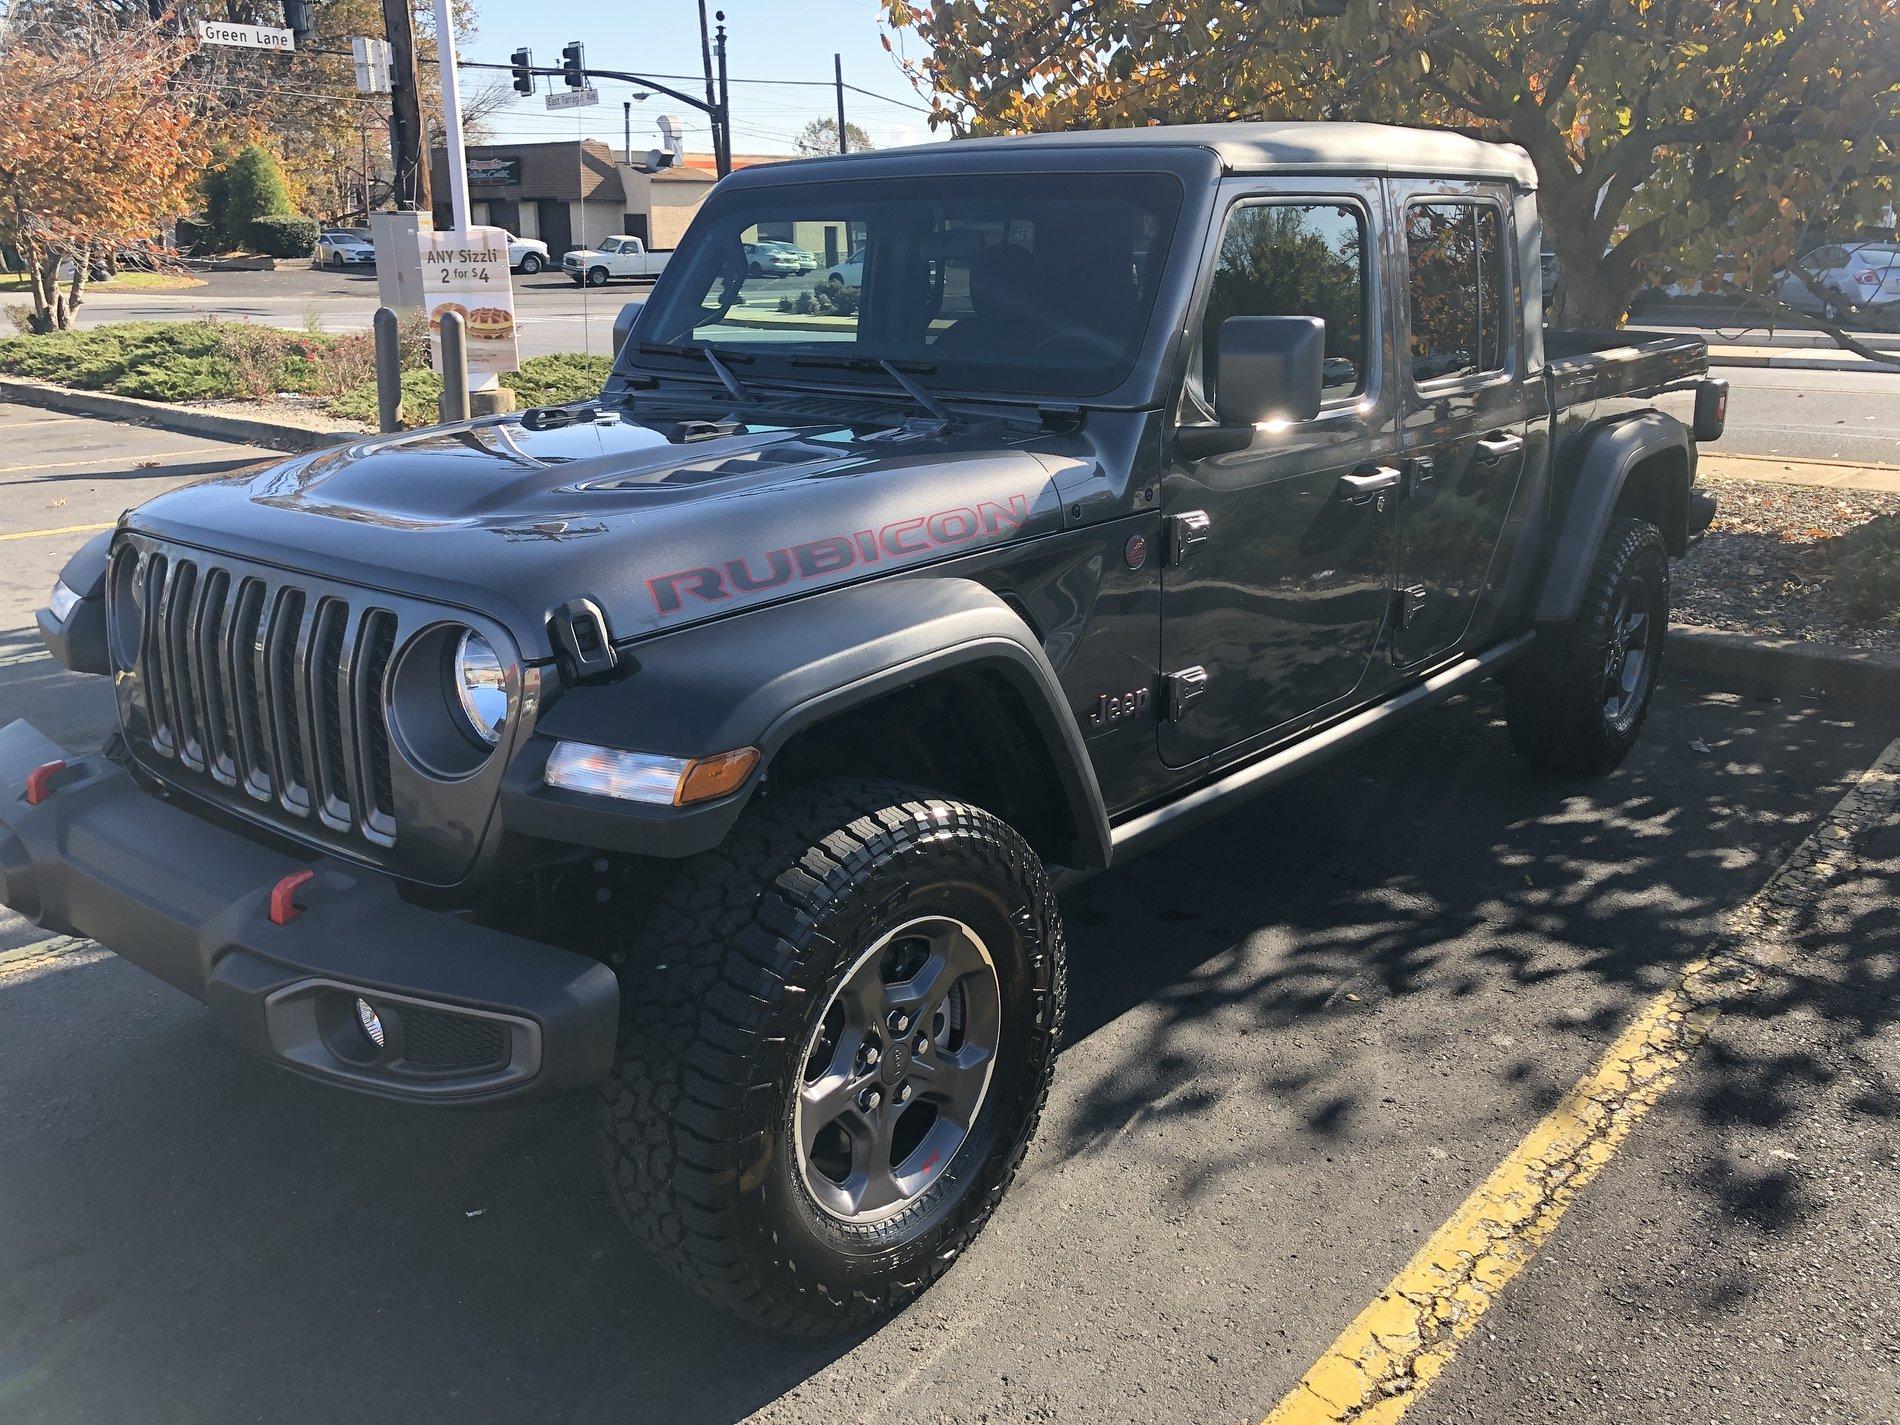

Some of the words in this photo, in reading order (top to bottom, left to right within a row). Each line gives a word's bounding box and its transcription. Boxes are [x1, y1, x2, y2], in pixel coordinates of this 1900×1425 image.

[205, 26, 247, 42] Green
[256, 31, 288, 46] Lane
[427, 250, 454, 263] ANY
[459, 248, 497, 263] Sizzli
[440, 268, 450, 283] 2
[453, 268, 468, 278] for
[645, 494, 1031, 618] RUBICON
[1089, 687, 1149, 728] Jeep
